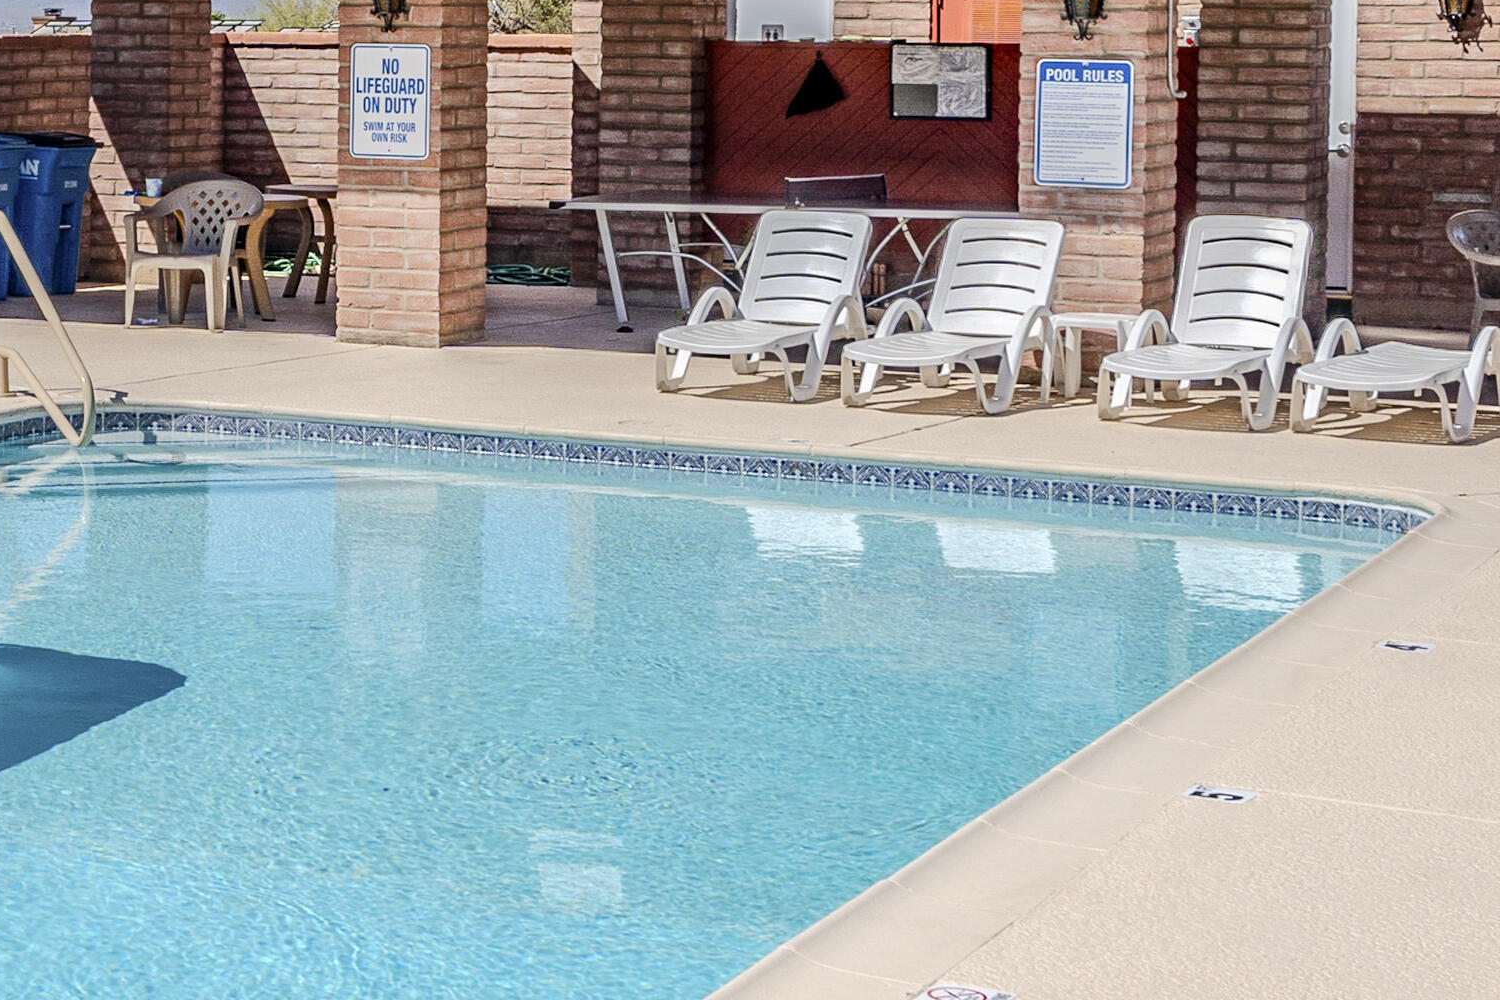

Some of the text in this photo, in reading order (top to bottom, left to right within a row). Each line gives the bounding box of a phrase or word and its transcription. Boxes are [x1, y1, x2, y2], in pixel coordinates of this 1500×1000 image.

[382, 58, 400, 75] NO
[1045, 68, 1125, 83] POOL RULES
[356, 77, 425, 95] LIFEGUARD
[363, 96, 418, 114] ON DUTY
[363, 121, 416, 133] SWIM AT YOUR
[371, 132, 408, 143] OWN RISK
